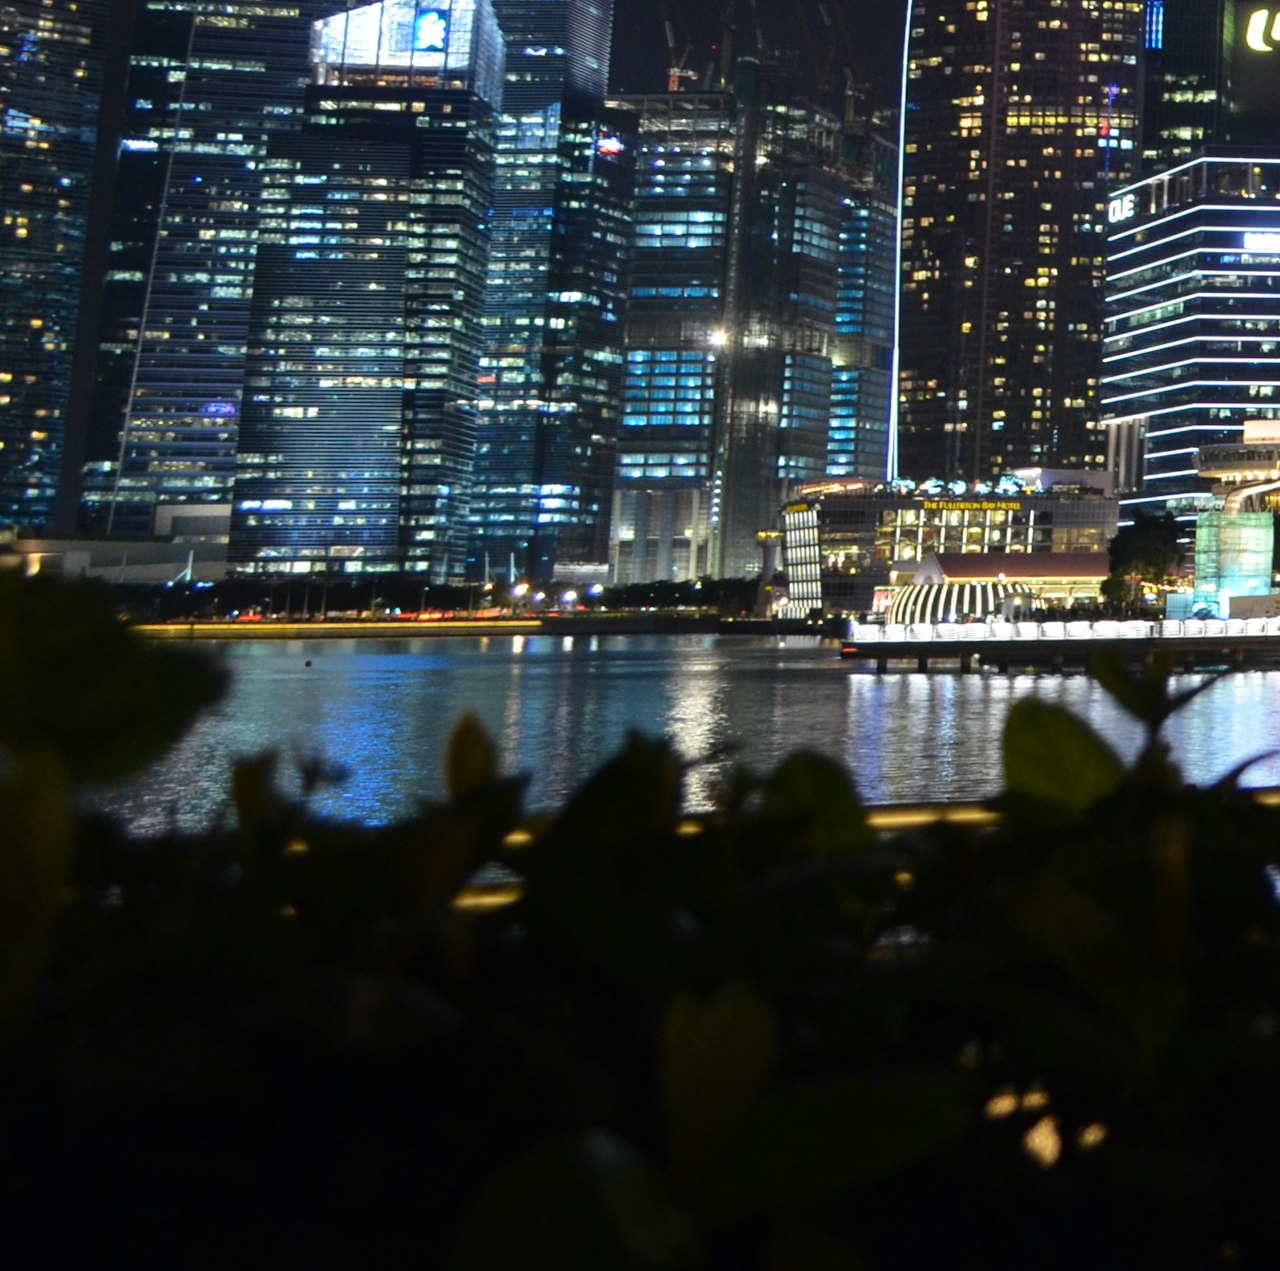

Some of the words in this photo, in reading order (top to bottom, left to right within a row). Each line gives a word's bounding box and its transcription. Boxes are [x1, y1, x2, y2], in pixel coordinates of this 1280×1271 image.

[923, 501, 938, 509] THE
[939, 501, 981, 510] FULLERTON
[982, 501, 996, 510] BAY
[997, 502, 1021, 510] HOTEL
